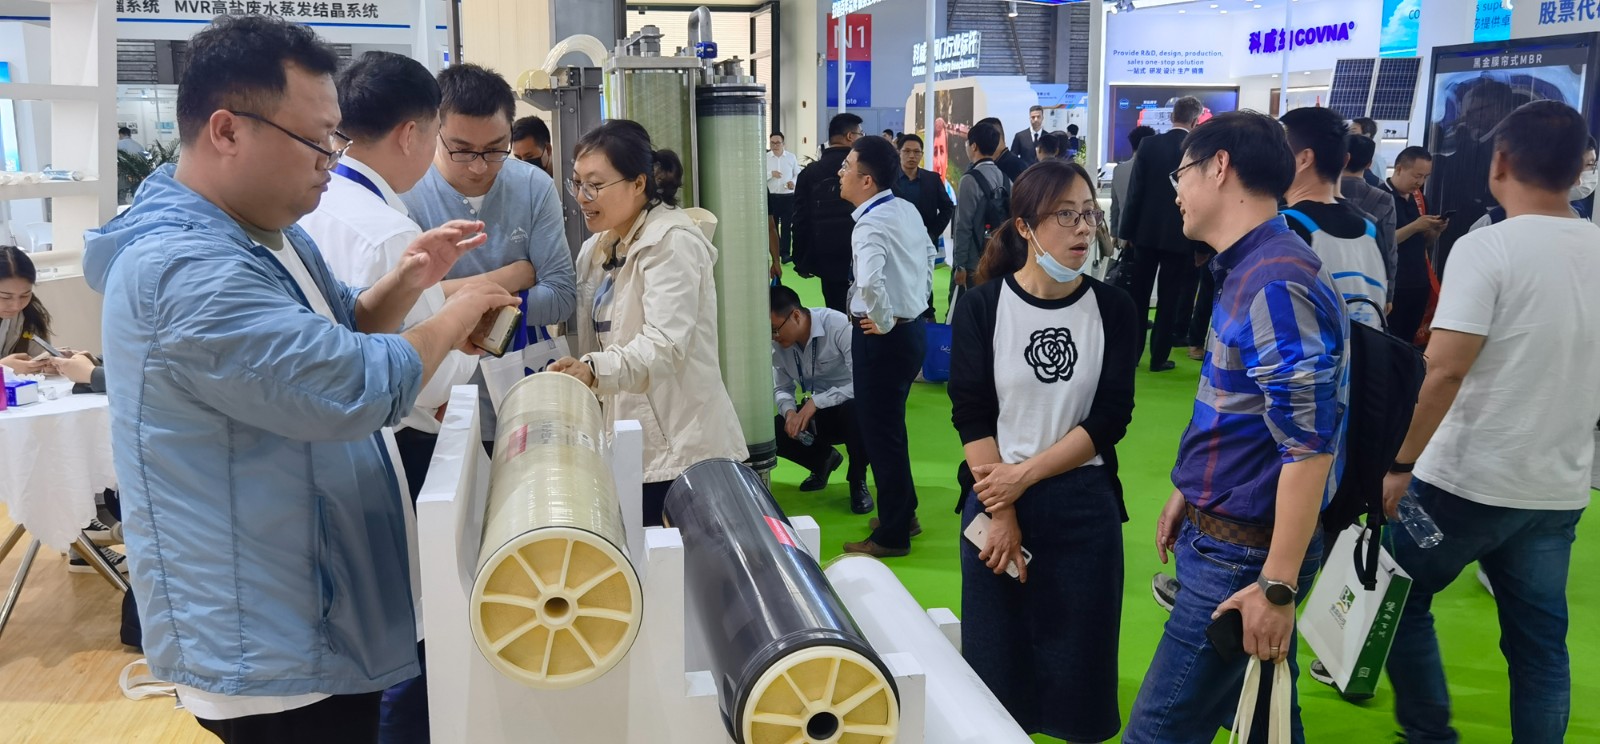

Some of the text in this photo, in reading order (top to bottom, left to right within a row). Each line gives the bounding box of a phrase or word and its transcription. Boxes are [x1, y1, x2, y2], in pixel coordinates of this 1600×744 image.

[175, 0, 379, 18] MVR高盐废水蒸发结晶系统
[1538, 0, 1600, 25] 股票代
[1295, 22, 1349, 46] COVNA
[1140, 49, 1158, 57] R&D,
[1159, 50, 1184, 58] design,
[1185, 50, 1224, 58] production,
[1145, 59, 1176, 67] one-stop
